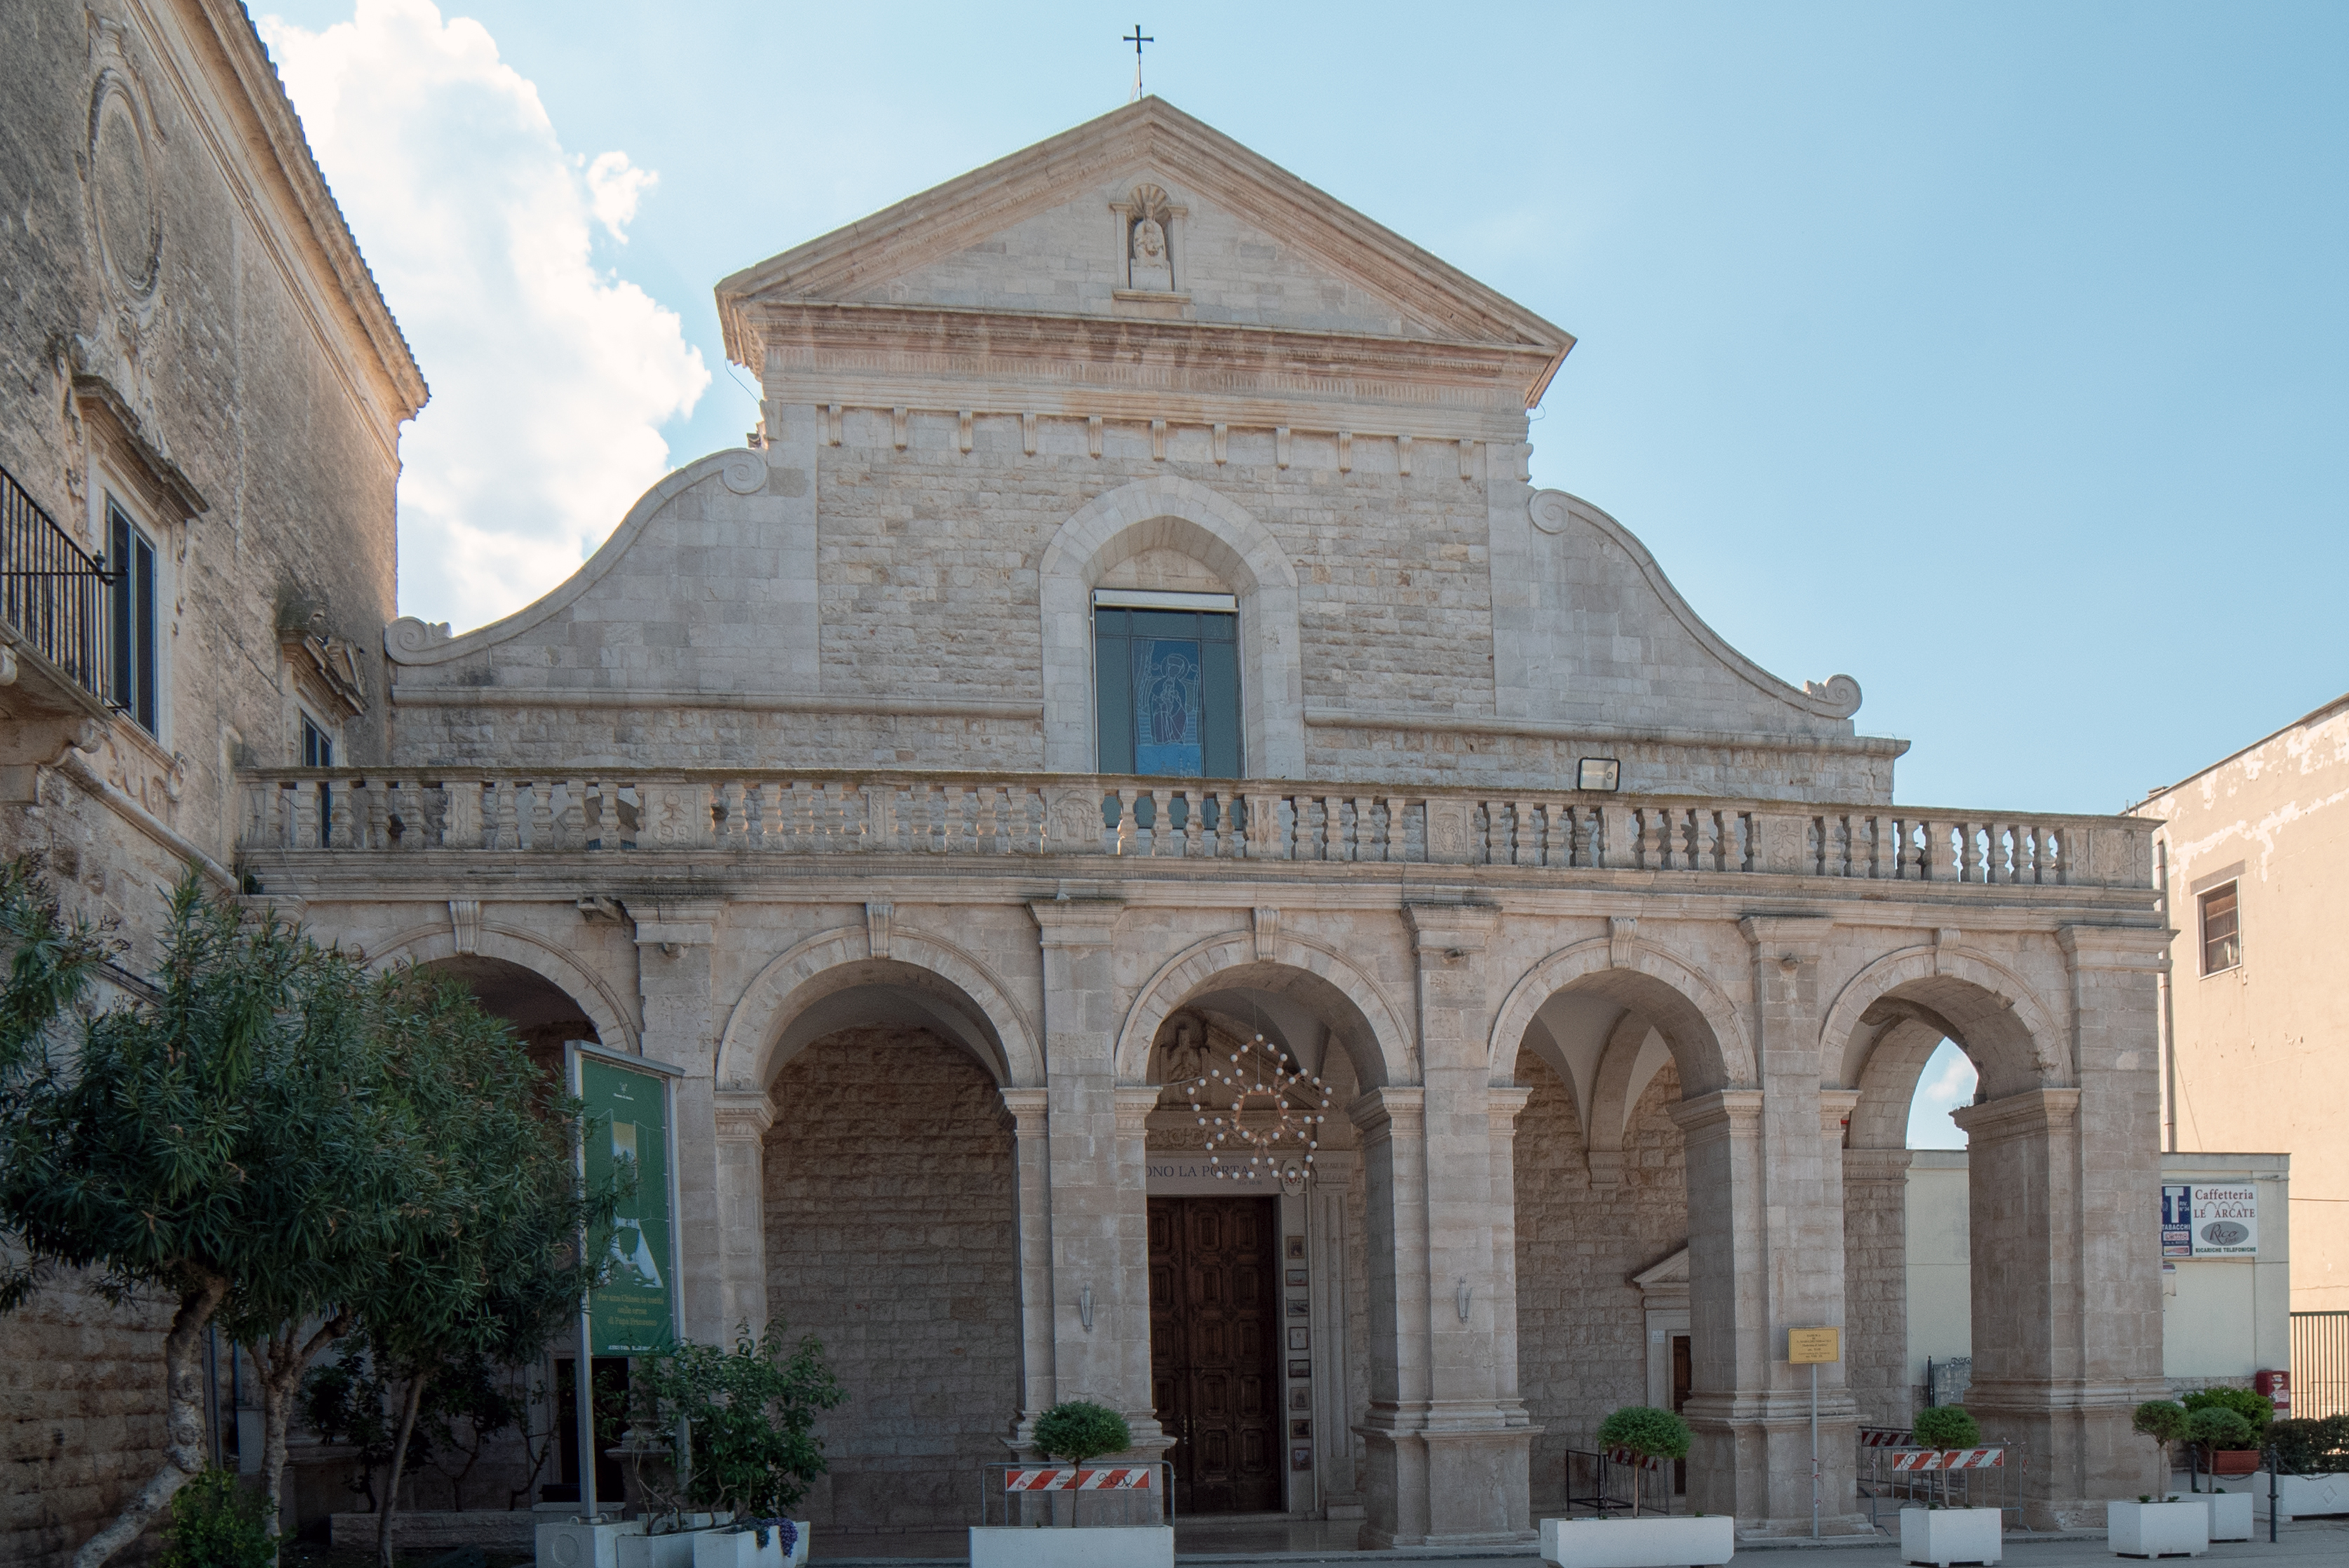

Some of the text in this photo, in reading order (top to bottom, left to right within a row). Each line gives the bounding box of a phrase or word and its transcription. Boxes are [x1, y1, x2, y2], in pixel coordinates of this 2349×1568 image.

[1179, 1165, 1197, 1177] LA
[2195, 1189, 2254, 1201] Caffetteria
[2165, 1187, 2184, 1224] T
[2194, 1208, 2256, 1218] LE ARCATE
